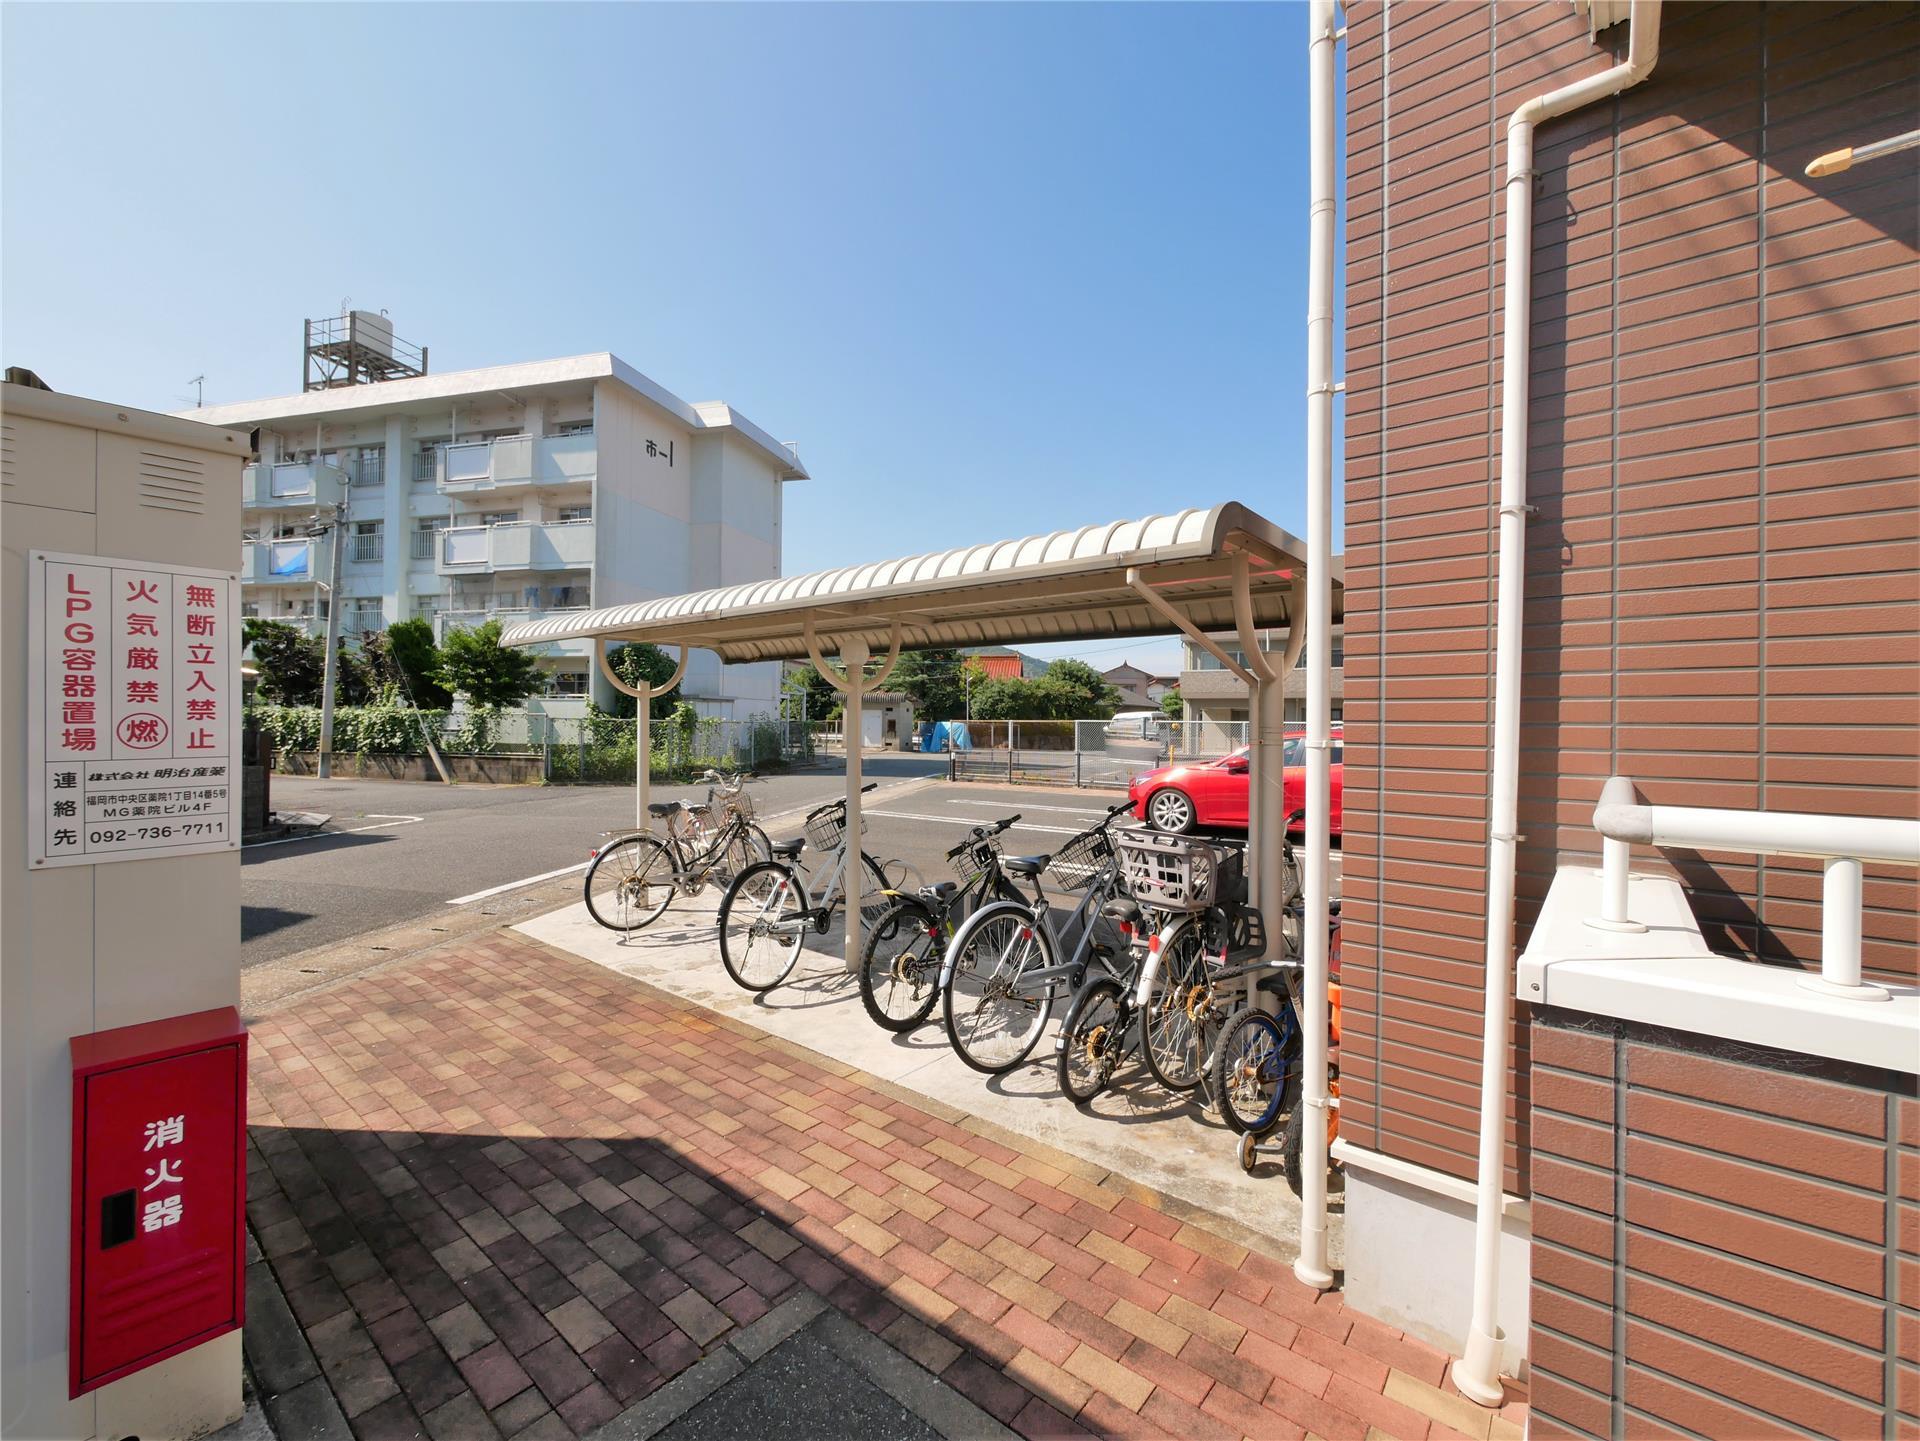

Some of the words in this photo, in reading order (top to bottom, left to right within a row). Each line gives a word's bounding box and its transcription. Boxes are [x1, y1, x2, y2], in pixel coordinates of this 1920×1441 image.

[62, 573, 97, 751] LPG容器置場
[126, 580, 159, 703] 火気厳禁
[186, 585, 216, 749] 無断立入禁止
[124, 717, 161, 745] 燃
[53, 772, 77, 846] 連絡先
[90, 822, 223, 843] 092-736-7711
[142, 1115, 185, 1233] 消火器
